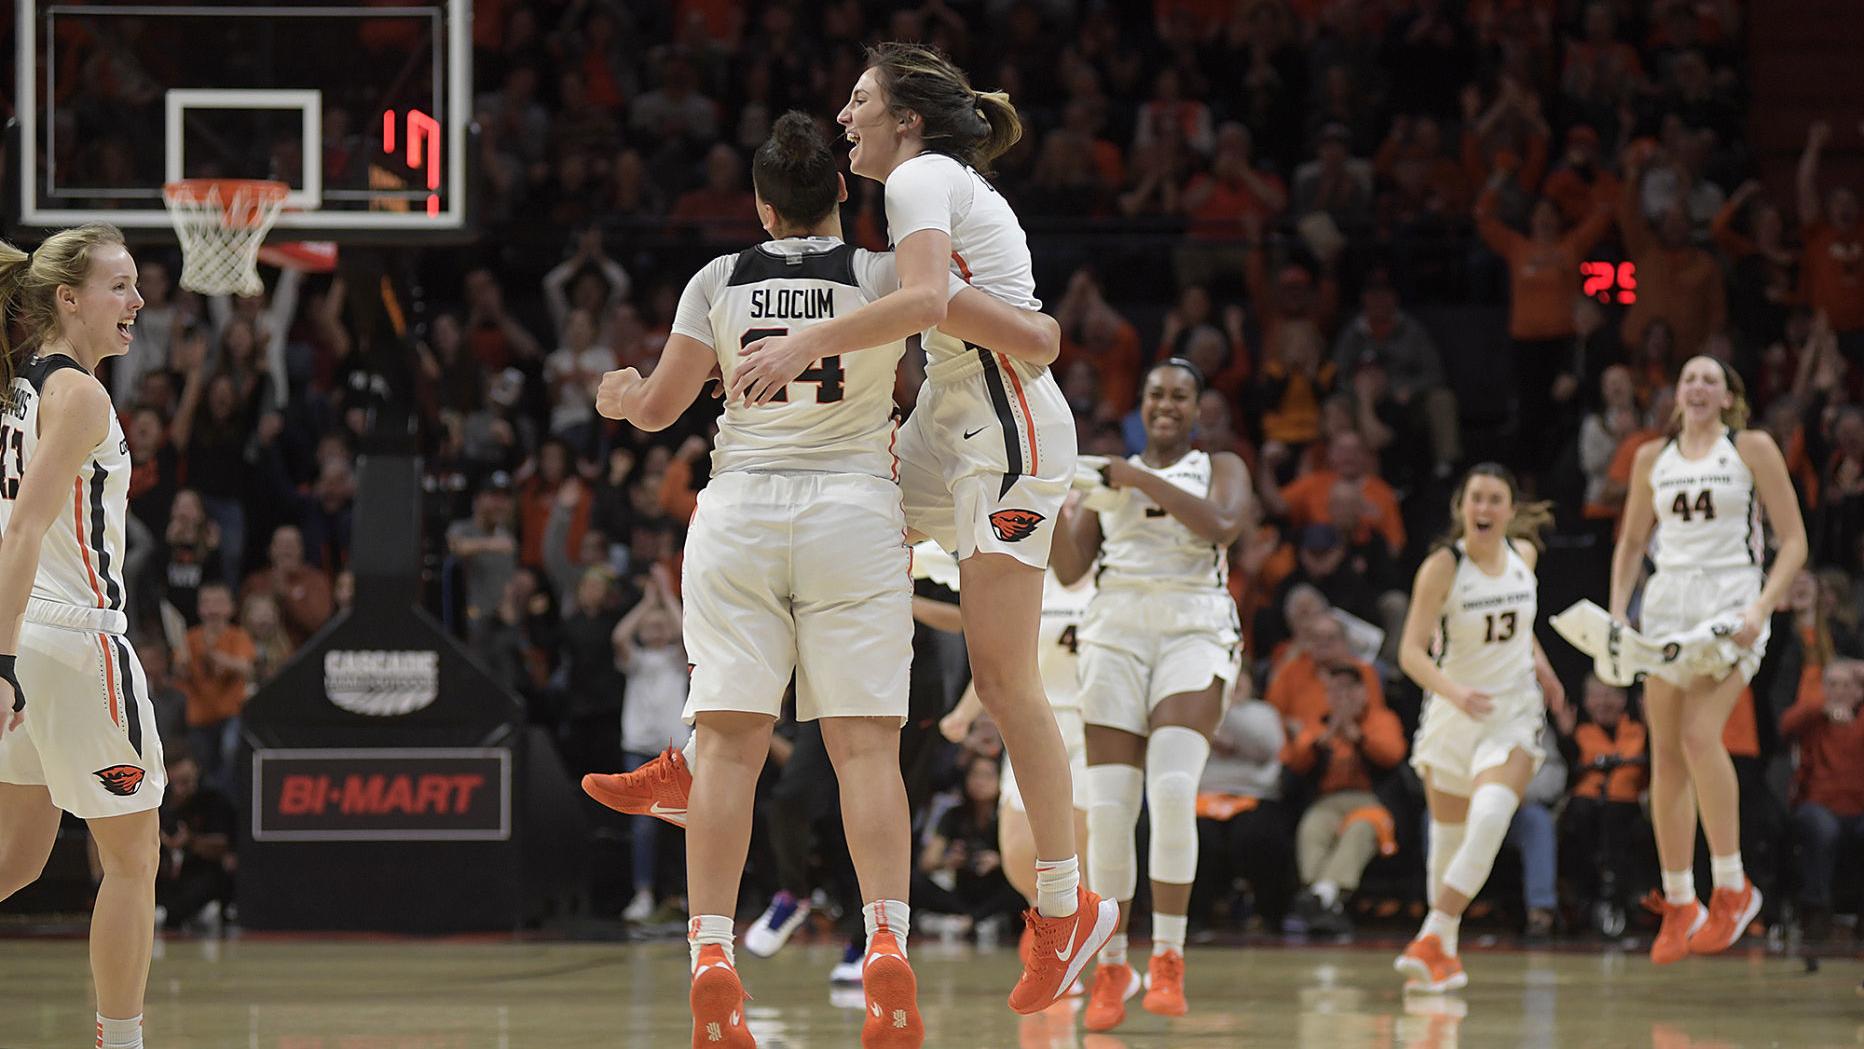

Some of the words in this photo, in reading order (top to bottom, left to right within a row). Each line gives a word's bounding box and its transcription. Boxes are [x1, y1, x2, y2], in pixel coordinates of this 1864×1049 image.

[750, 288, 835, 318] SLOCUM
[1672, 491, 1715, 521] 44
[1484, 611, 1516, 643] 13
